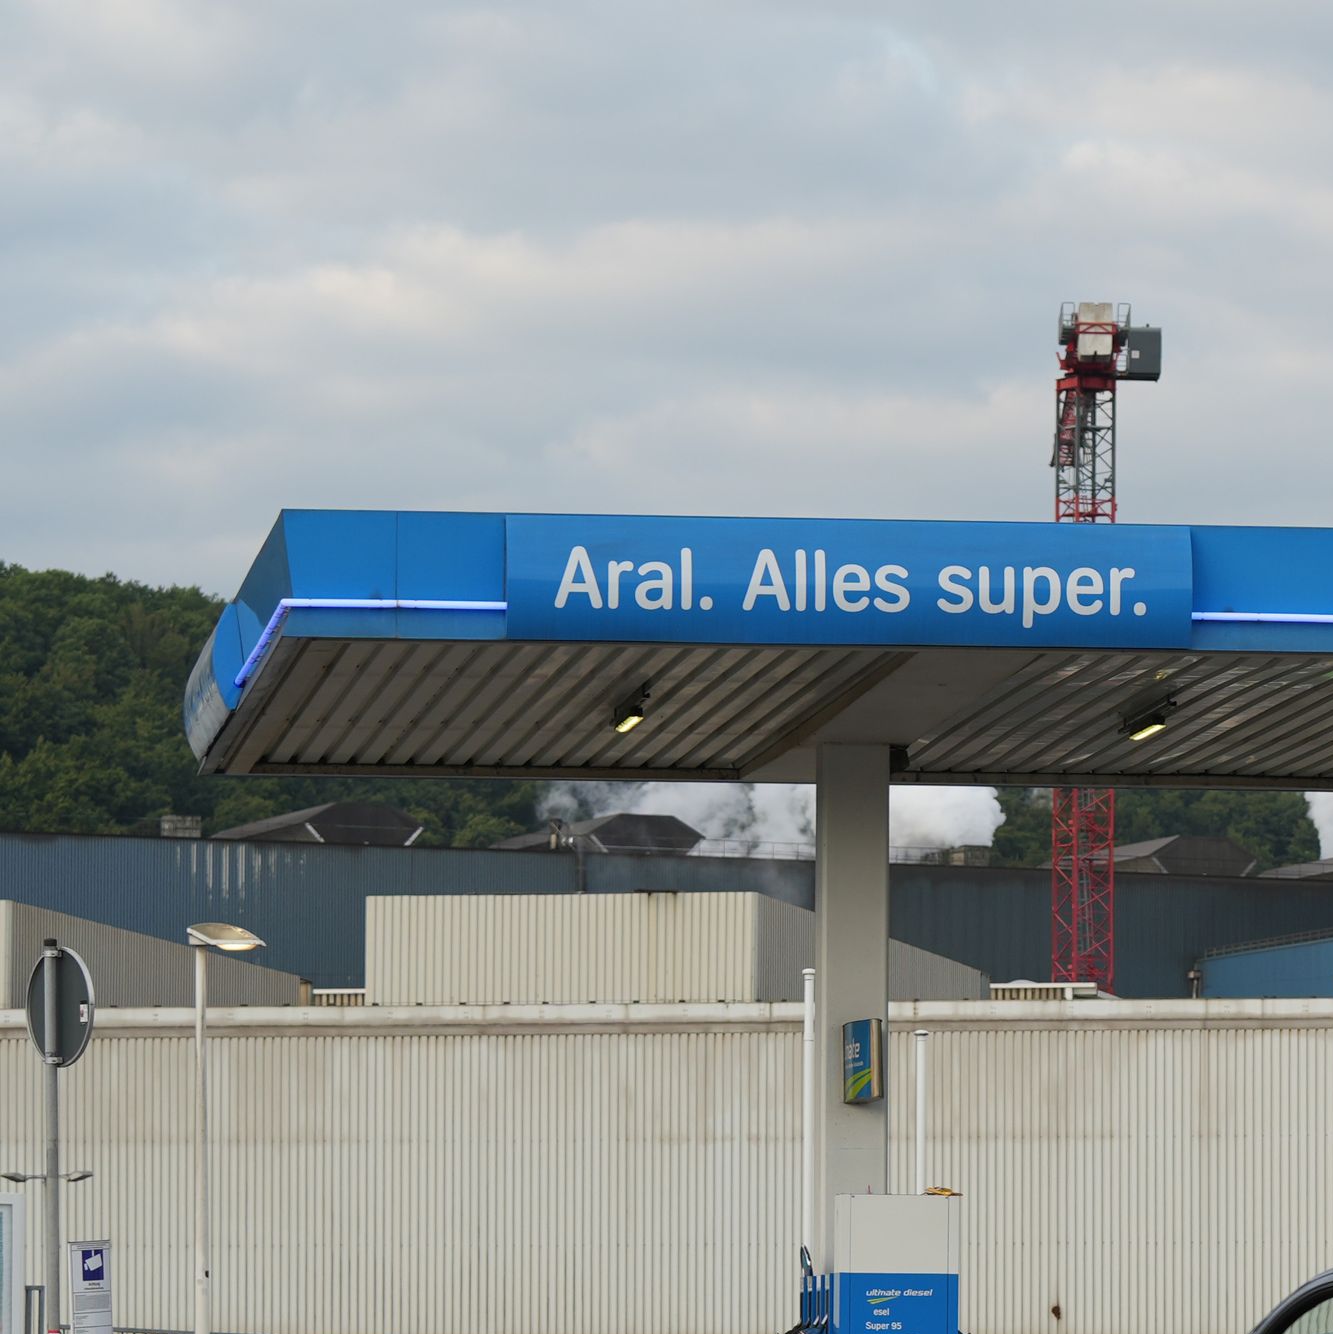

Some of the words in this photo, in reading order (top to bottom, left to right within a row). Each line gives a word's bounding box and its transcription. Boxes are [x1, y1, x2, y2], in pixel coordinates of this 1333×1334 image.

[553, 545, 714, 611] Aral.
[742, 548, 912, 614] Alles
[936, 564, 1148, 629] super.
[865, 1288, 901, 1297] ultimate
[903, 1288, 933, 1297] diesel
[865, 1321, 889, 1331] Super
[891, 1322, 902, 1330] 95
